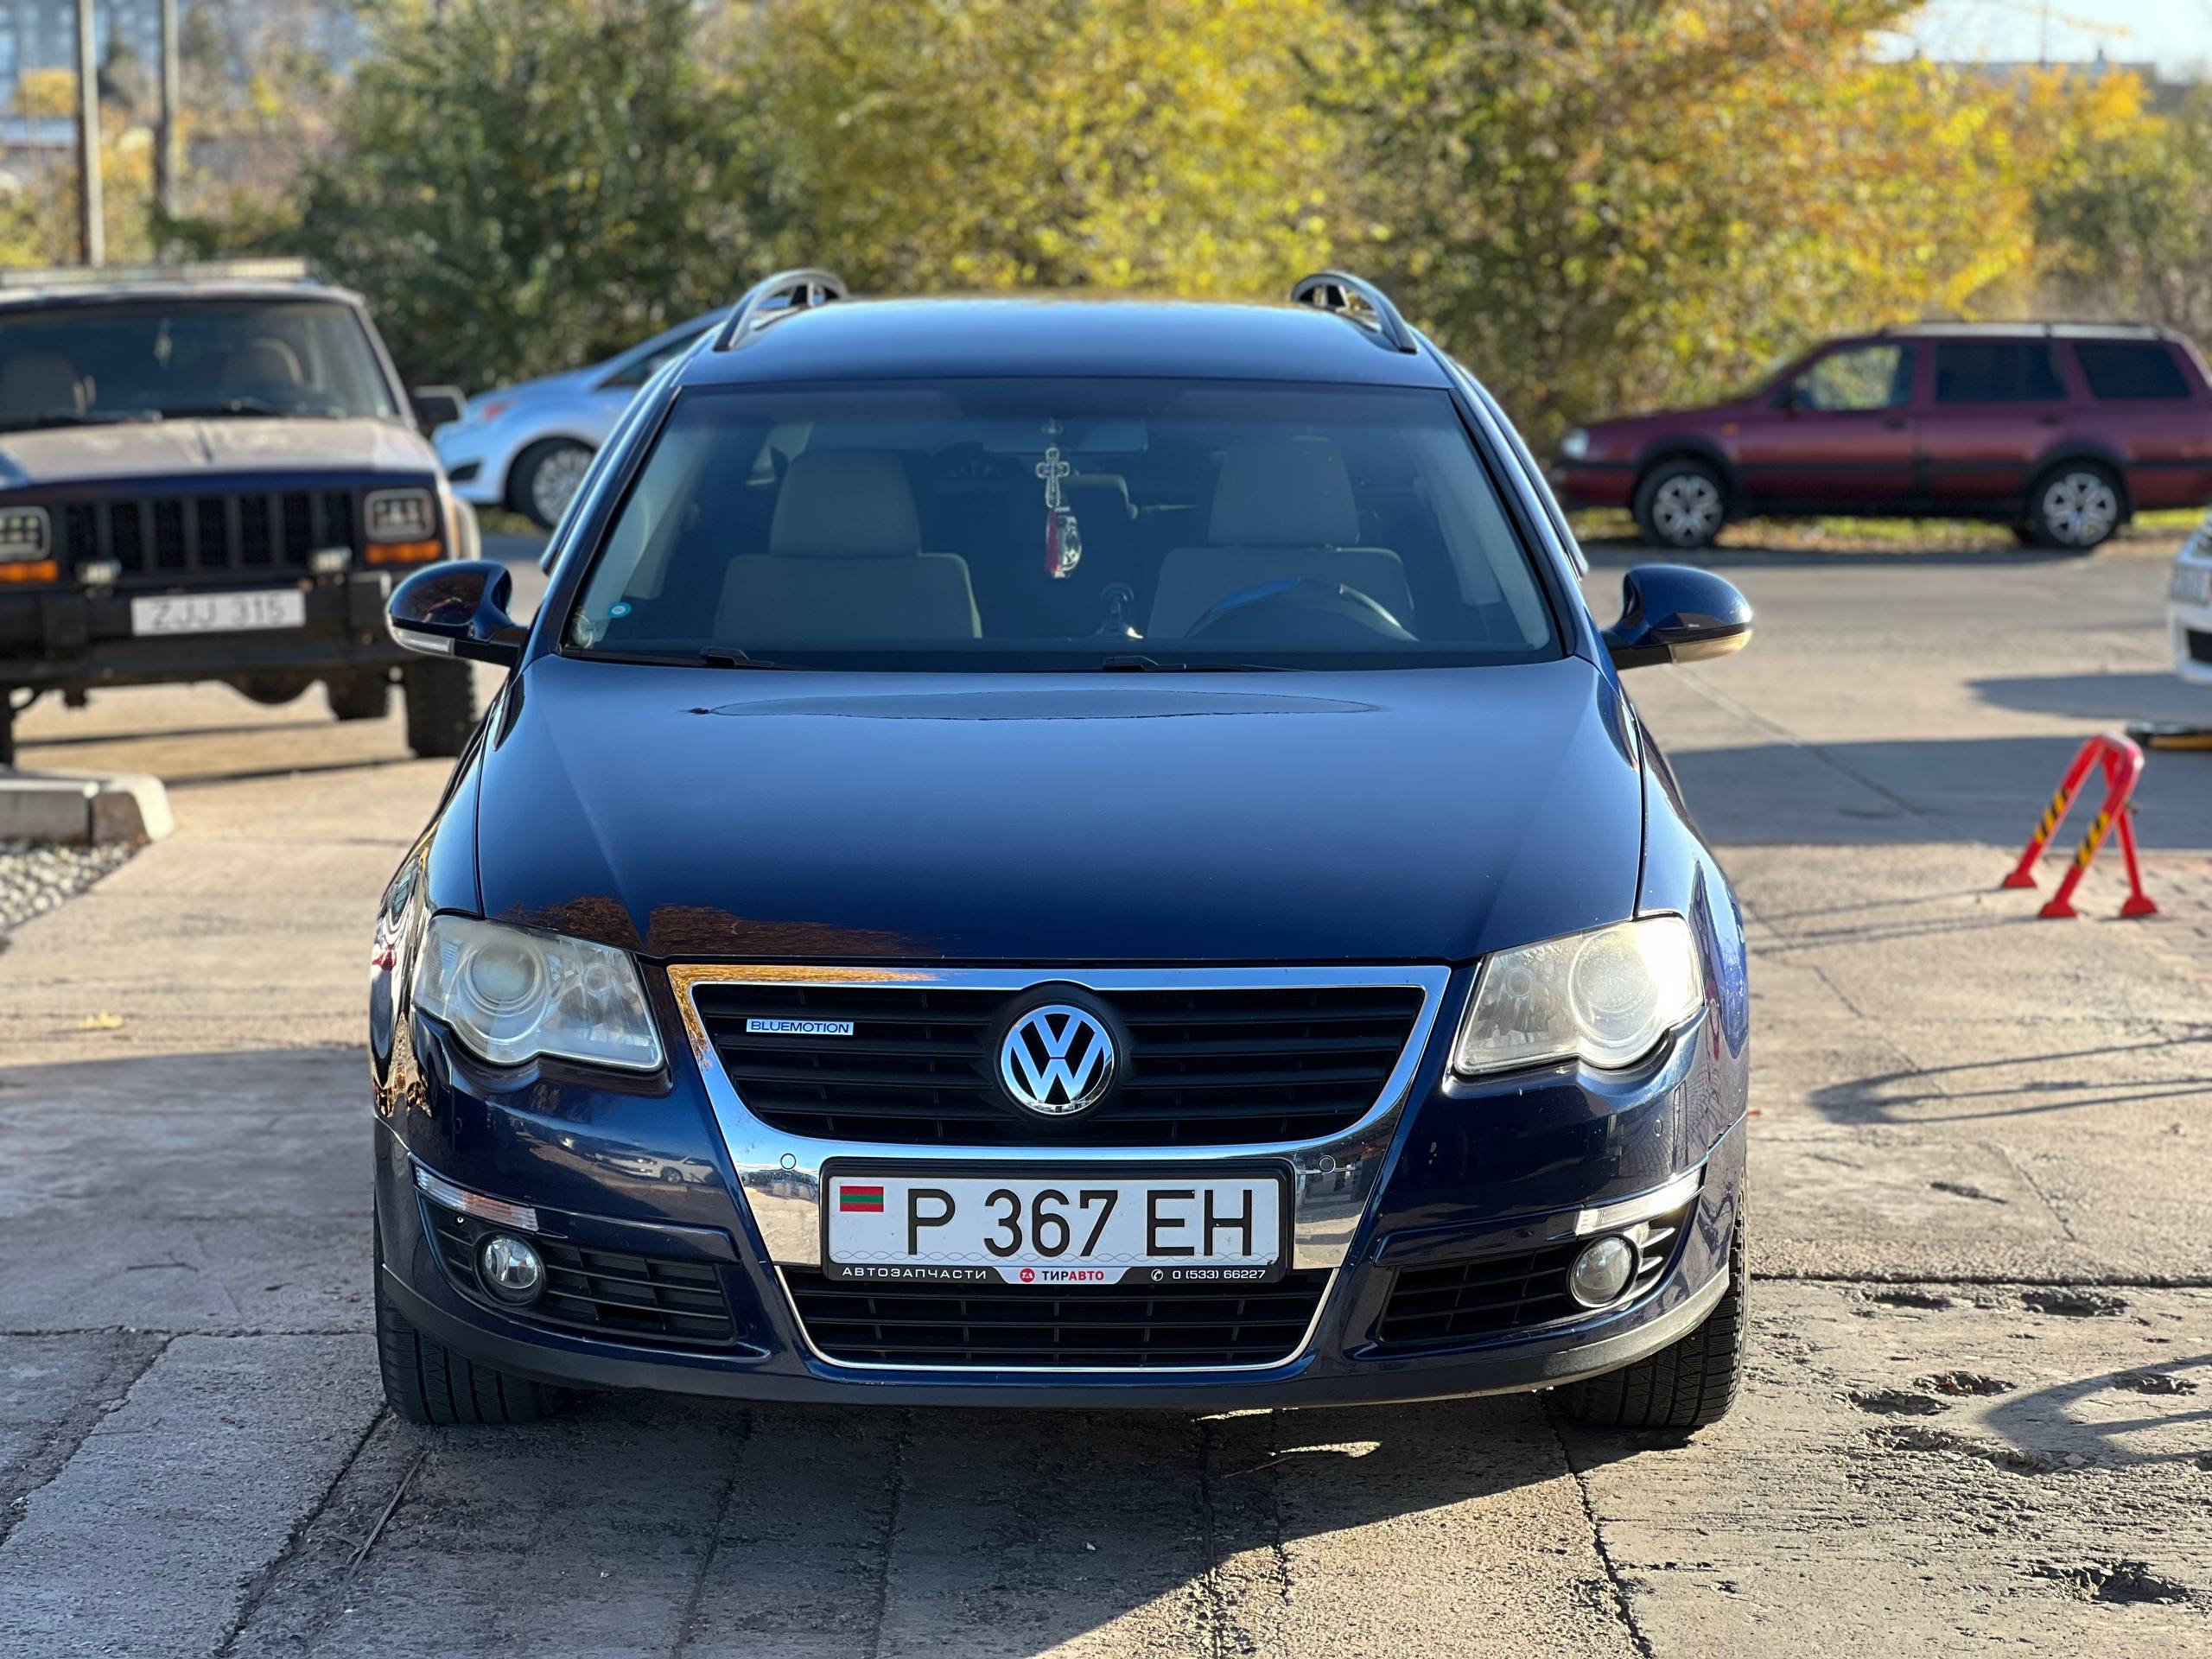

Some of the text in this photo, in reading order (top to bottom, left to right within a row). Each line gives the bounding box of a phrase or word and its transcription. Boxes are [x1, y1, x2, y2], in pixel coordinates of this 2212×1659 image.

[750, 1020, 850, 1034] BLUEMOTION
[906, 1188, 1252, 1258] P 367 EH
[842, 1267, 987, 1280] АВТОЗАПЧАСТИ
[1041, 1269, 1105, 1281] ТИРАВТО
[1172, 1269, 1266, 1280] 0 (533) 66227
